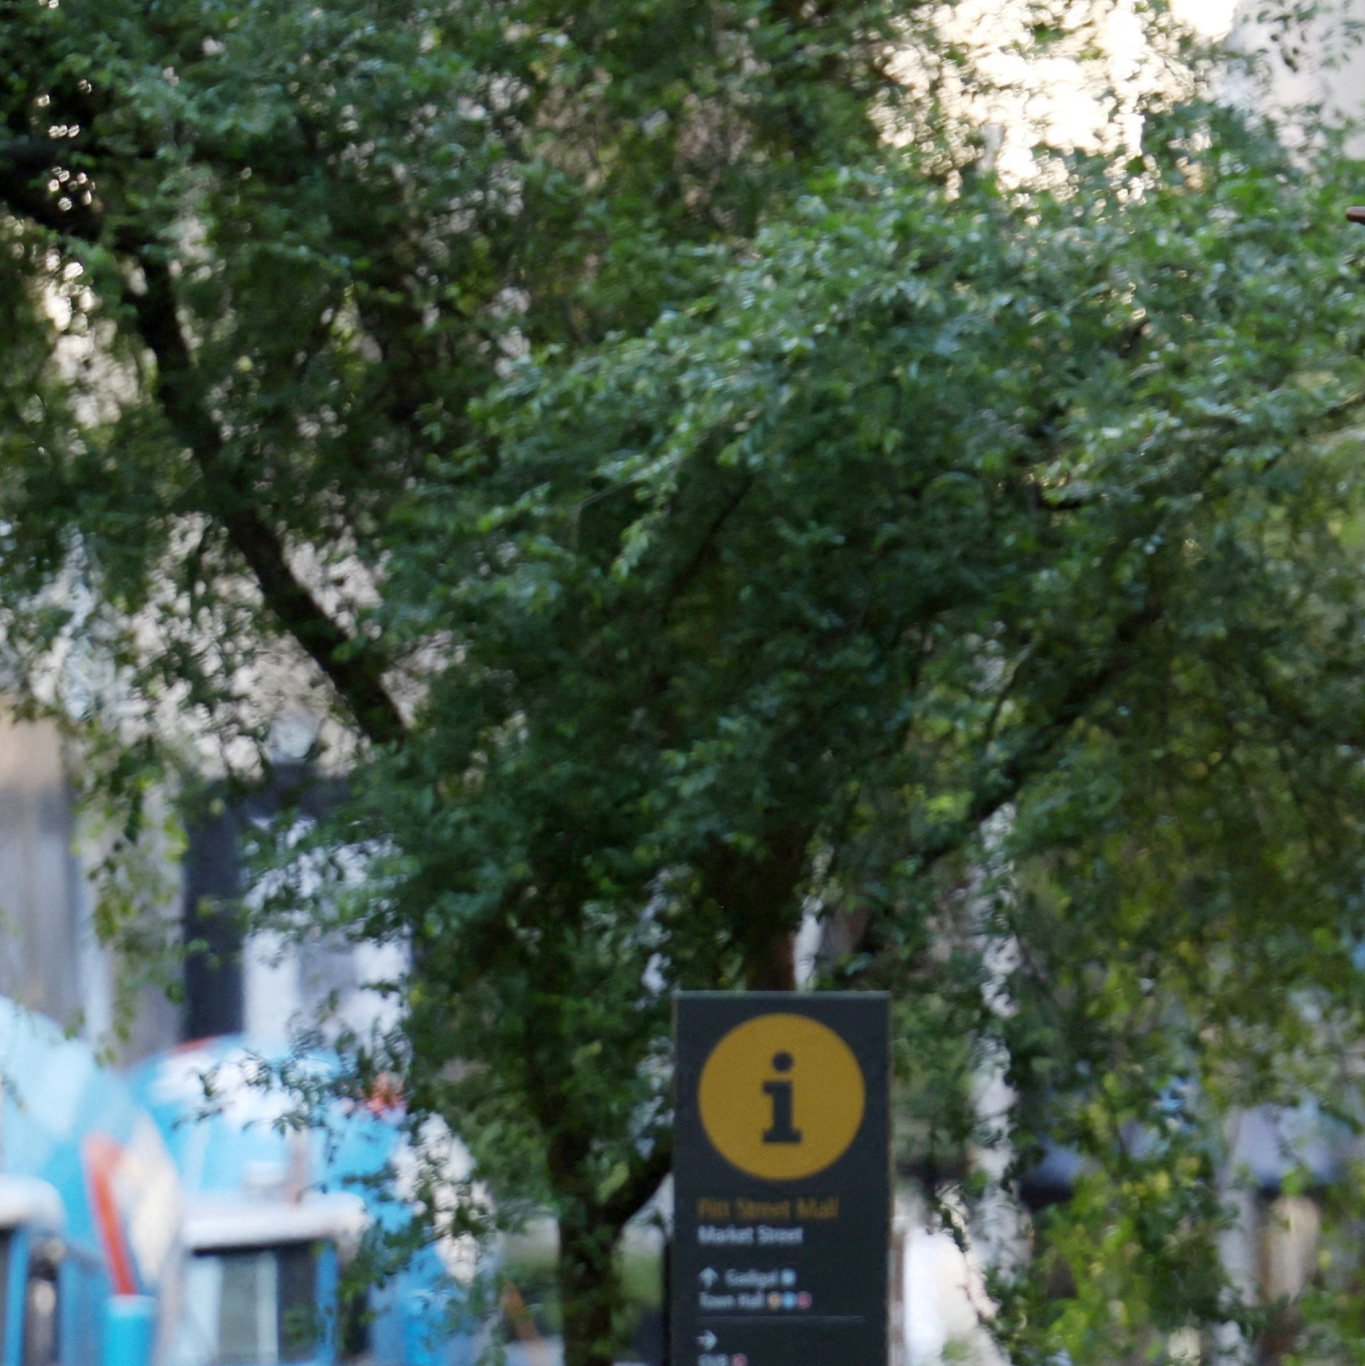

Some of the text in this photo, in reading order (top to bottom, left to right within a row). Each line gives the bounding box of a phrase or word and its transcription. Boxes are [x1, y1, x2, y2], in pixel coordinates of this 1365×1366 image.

[736, 1198, 790, 1220] Street
[698, 1224, 803, 1244] Market Street
